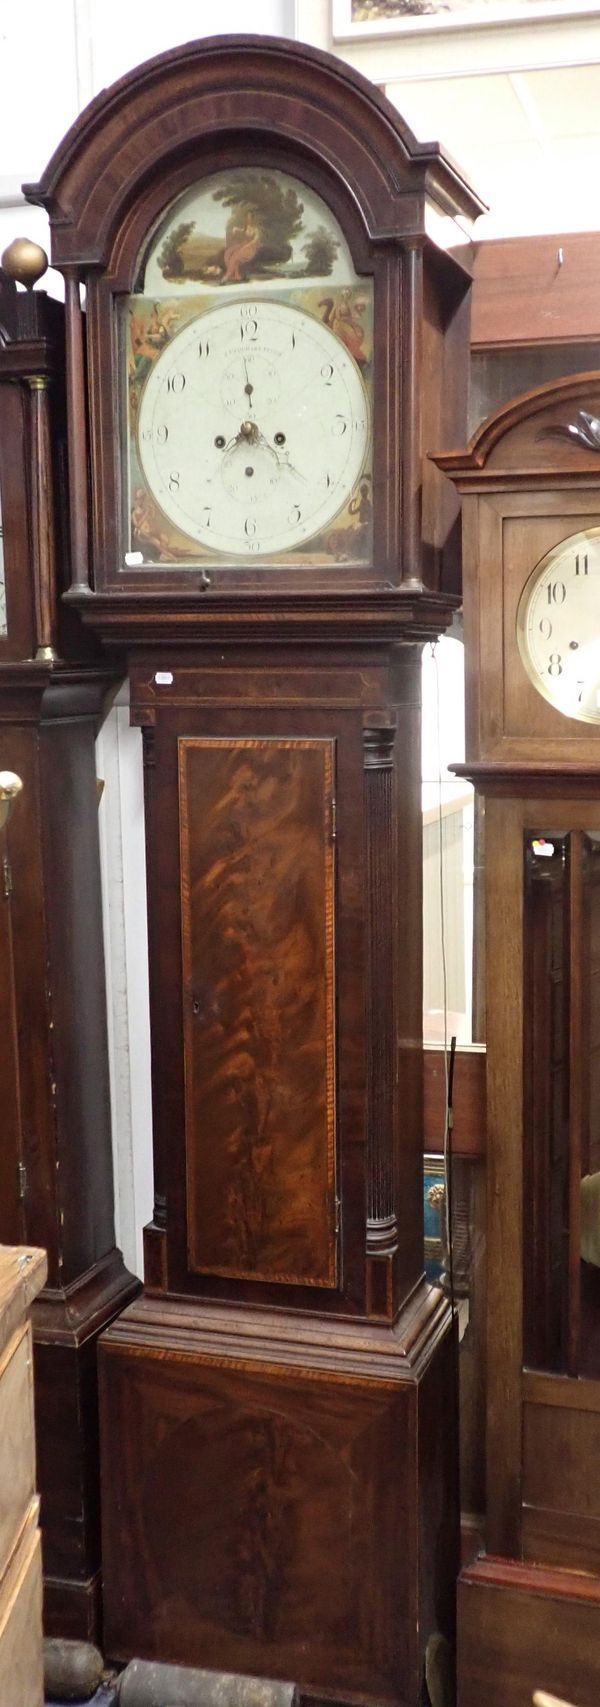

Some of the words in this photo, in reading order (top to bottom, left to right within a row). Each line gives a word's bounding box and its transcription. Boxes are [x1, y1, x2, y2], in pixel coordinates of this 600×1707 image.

[240, 305, 258, 317] 60
[240, 319, 258, 342] 12
[291, 331, 296, 350] 1
[199, 340, 210, 359] 11
[166, 373, 186, 393] 10
[320, 363, 334, 386] 2
[157, 424, 169, 445] 9
[331, 414, 347, 437] 3
[168, 471, 180, 492] 8
[202, 505, 213, 527] 7
[286, 504, 301, 525] 5
[243, 517, 257, 537] 6
[574, 554, 589, 576] 11
[546, 581, 567, 606] 10
[539, 617, 553, 640] 9
[547, 653, 563, 676] 8
[576, 680, 585, 703] 7
